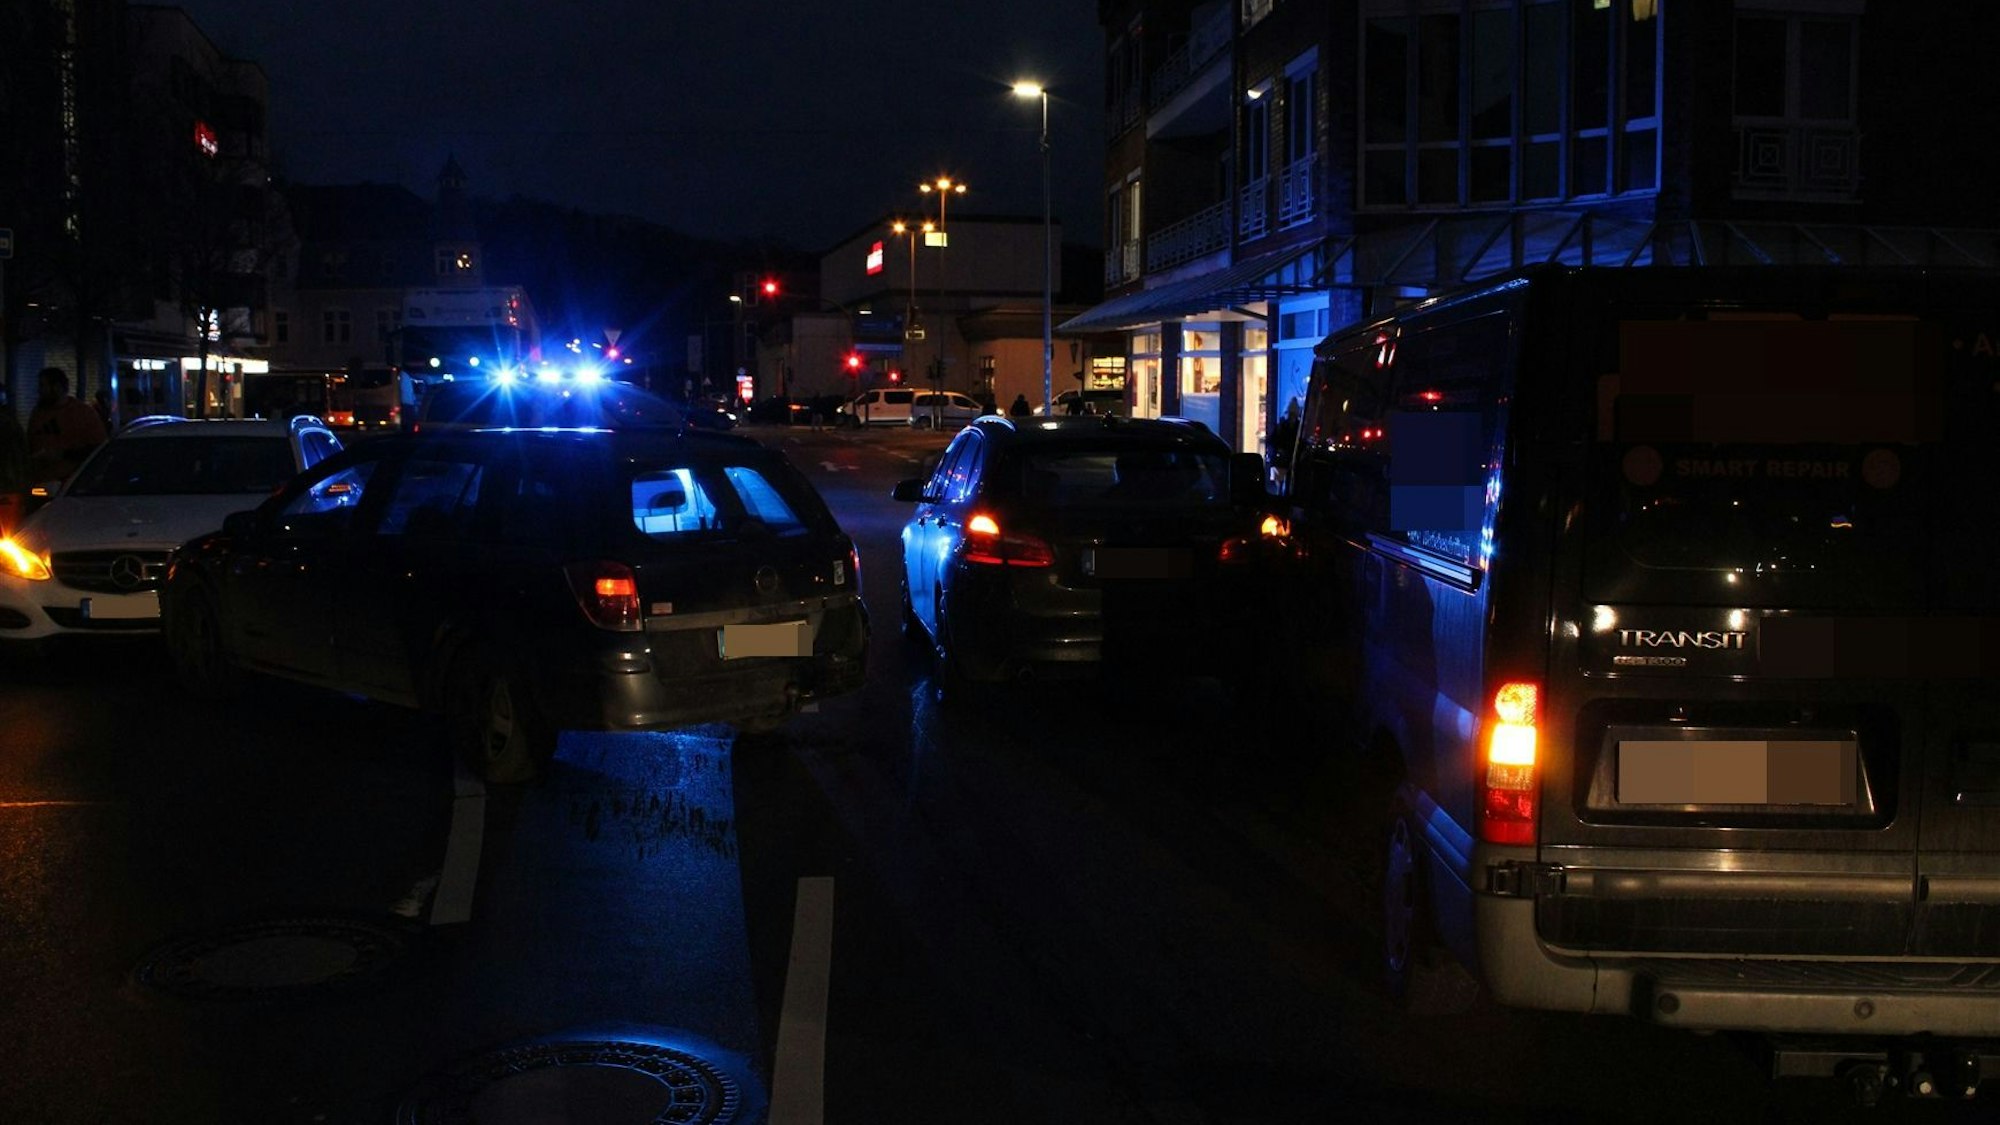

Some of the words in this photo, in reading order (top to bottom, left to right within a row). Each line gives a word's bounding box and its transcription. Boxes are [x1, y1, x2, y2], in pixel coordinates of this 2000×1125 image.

[1676, 459, 1758, 478] SMART
[1766, 460, 1850, 479] REPAIR
[1618, 628, 1747, 649] TRANSIT
